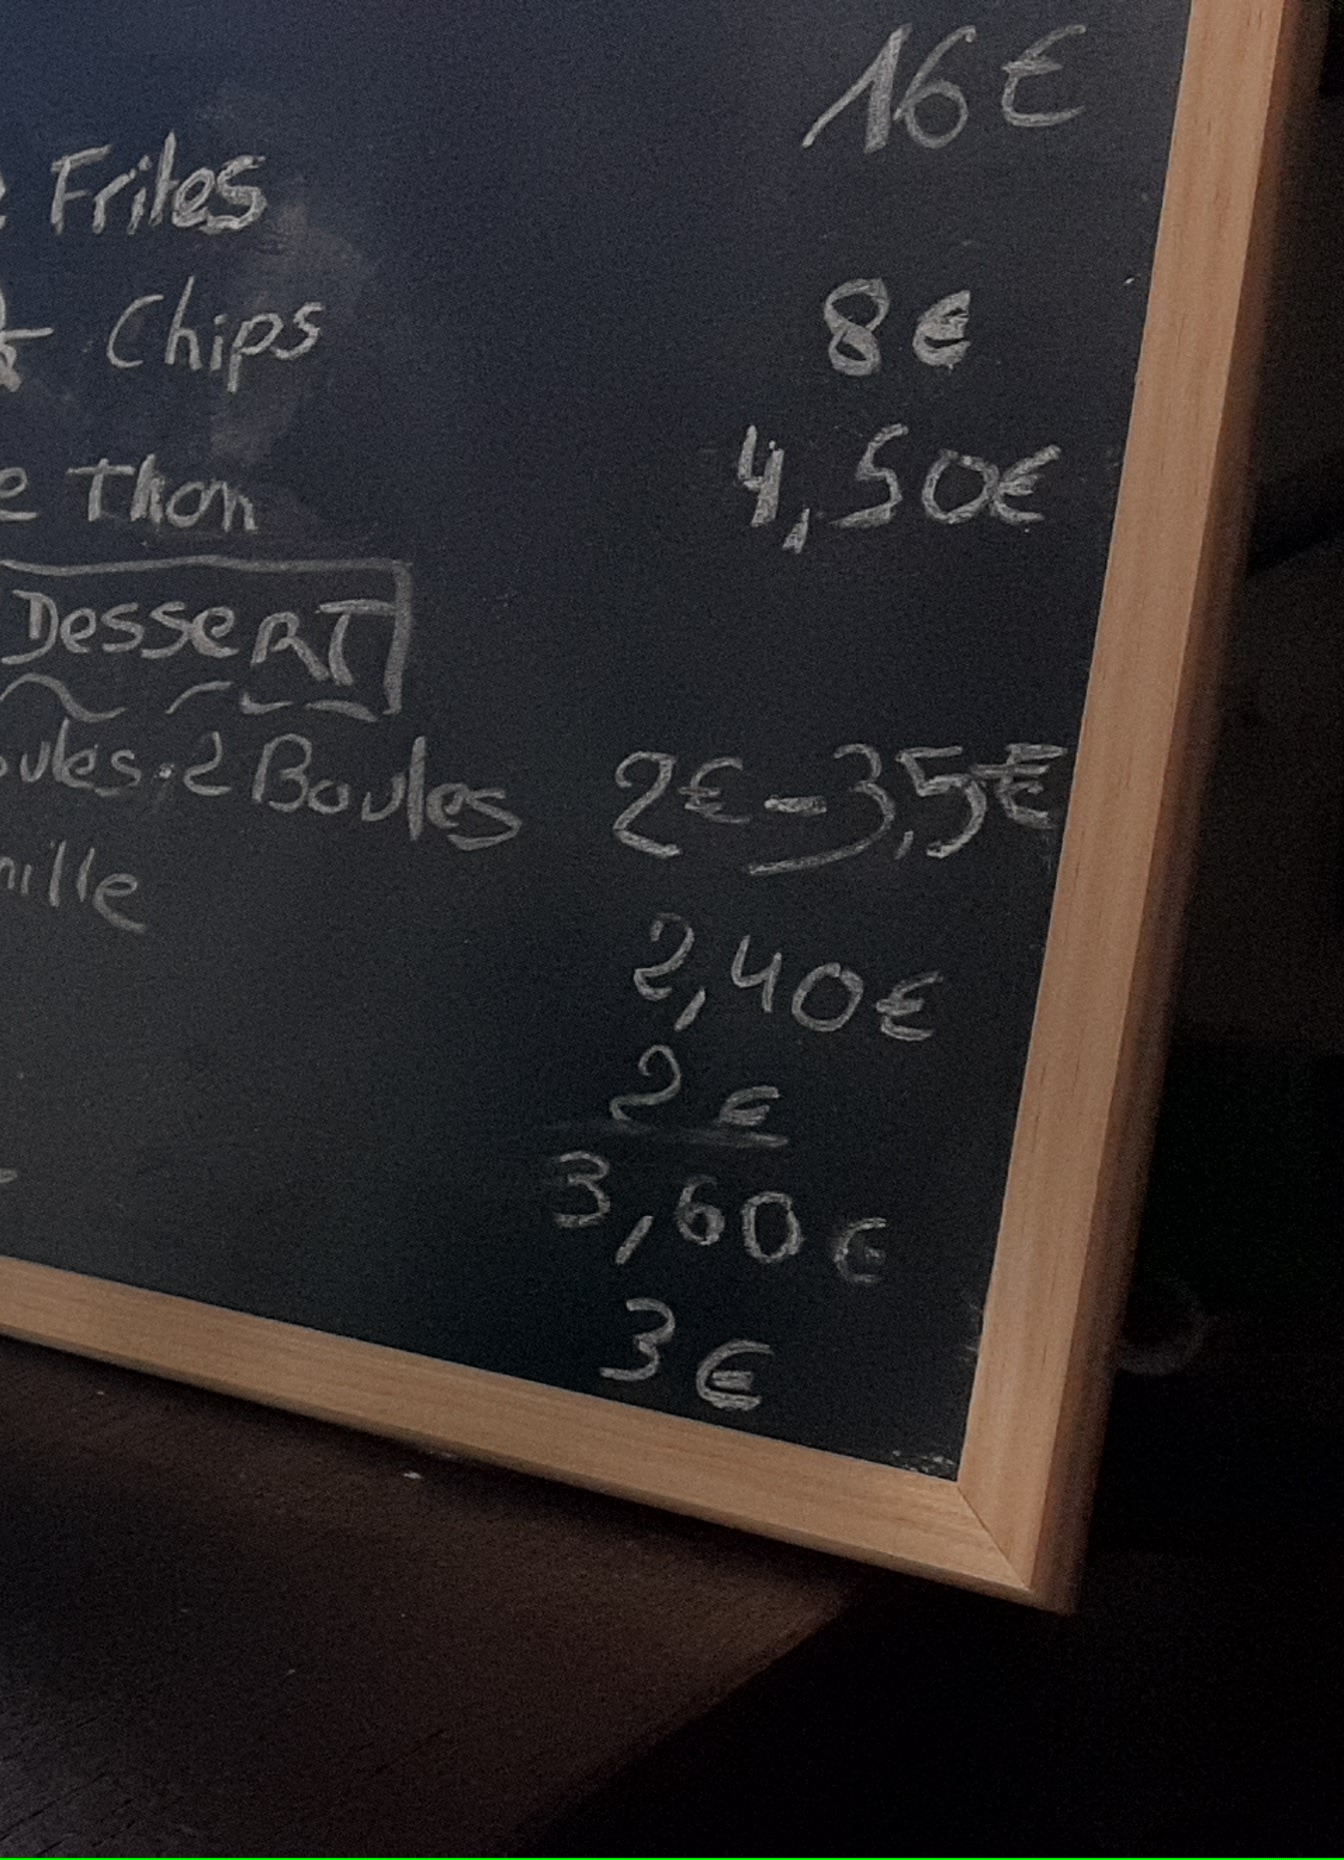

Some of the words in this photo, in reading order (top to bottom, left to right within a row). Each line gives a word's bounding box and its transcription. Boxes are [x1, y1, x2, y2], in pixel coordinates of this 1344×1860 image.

[108, 275, 325, 393] Chips
[736, 423, 1062, 555] 4,50€
[252, 731, 523, 852] Boules
[632, 912, 944, 1042] 2,40€
